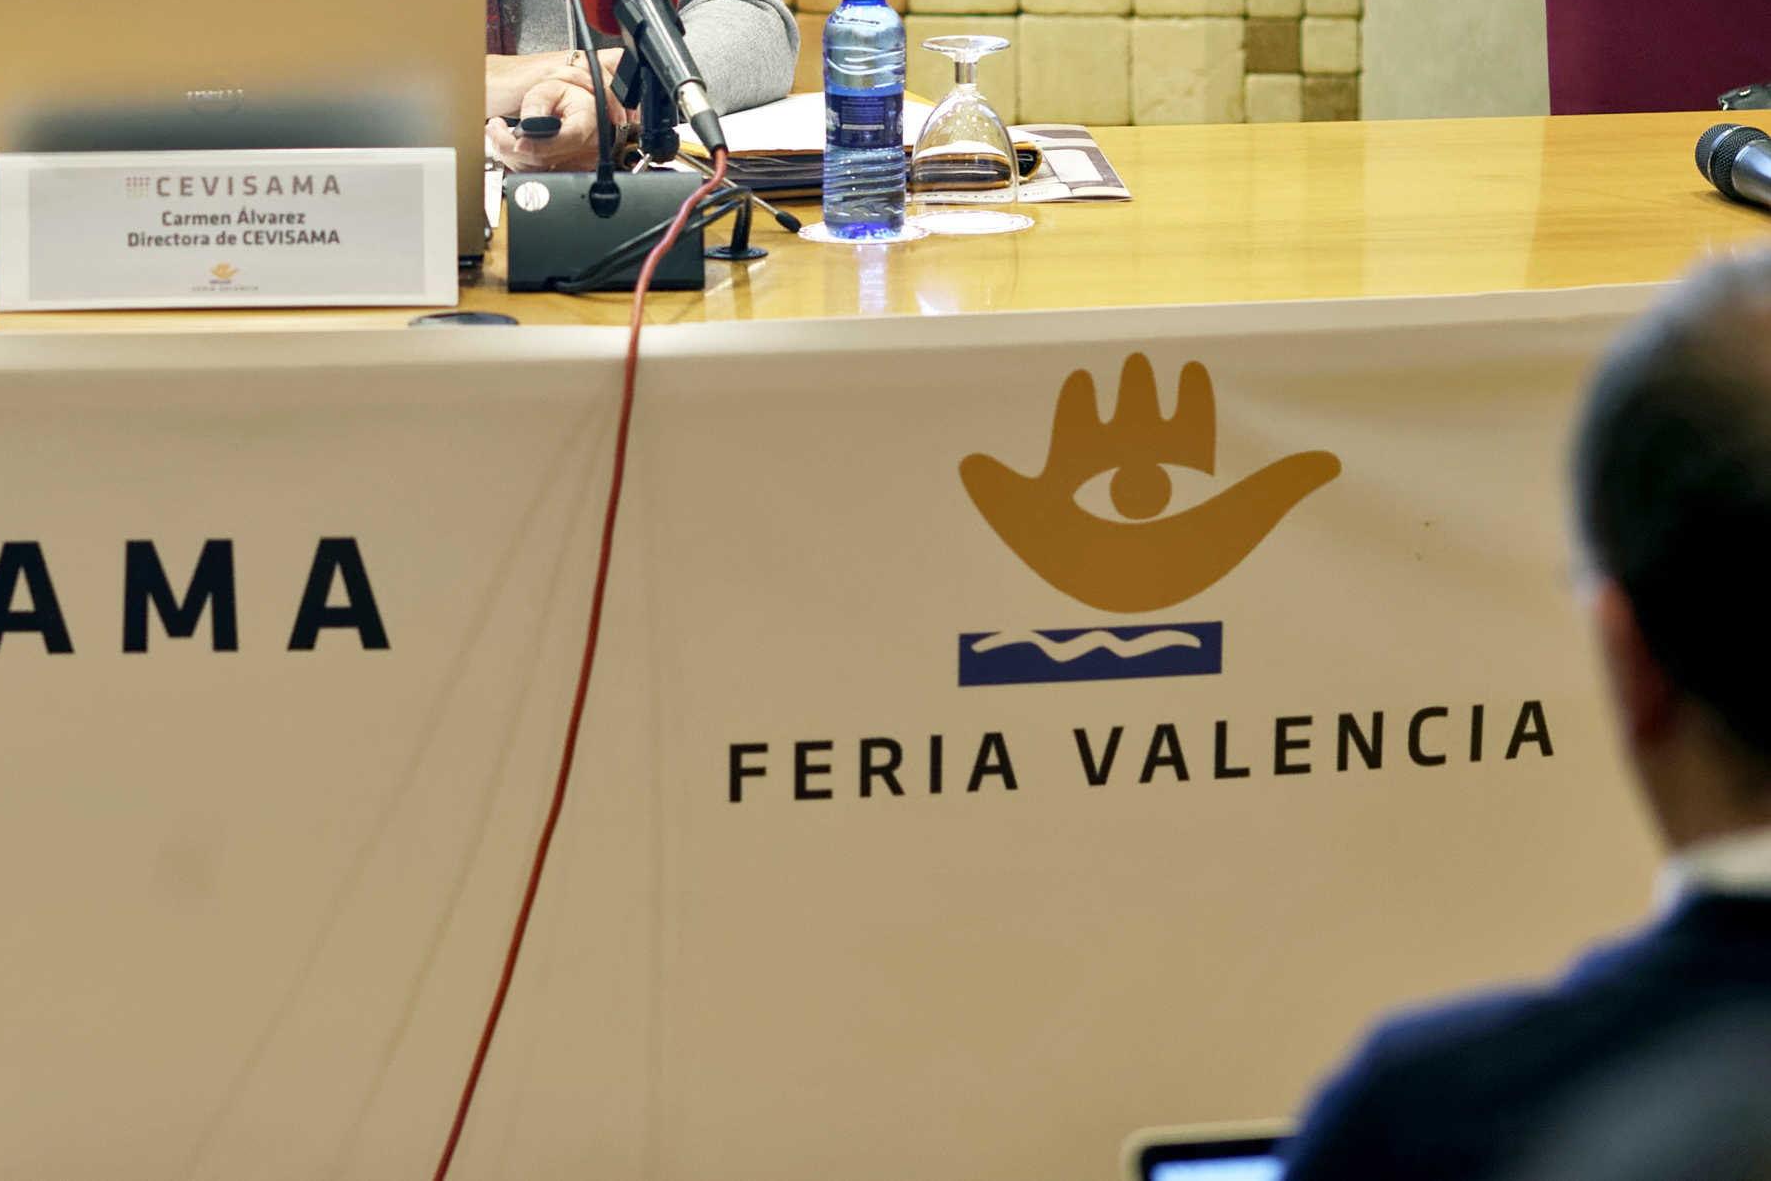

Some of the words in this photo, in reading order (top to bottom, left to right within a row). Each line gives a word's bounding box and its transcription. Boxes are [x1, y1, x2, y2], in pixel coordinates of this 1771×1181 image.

[156, 174, 341, 197] CEVISAMA
[161, 211, 232, 227] Carmen
[237, 206, 306, 225] Álvarez
[127, 231, 211, 248] Directora
[215, 230, 238, 246] de
[242, 229, 341, 246] CEVISAMA
[727, 730, 1020, 804] FERIA
[1072, 698, 1556, 787] VALENCIA
